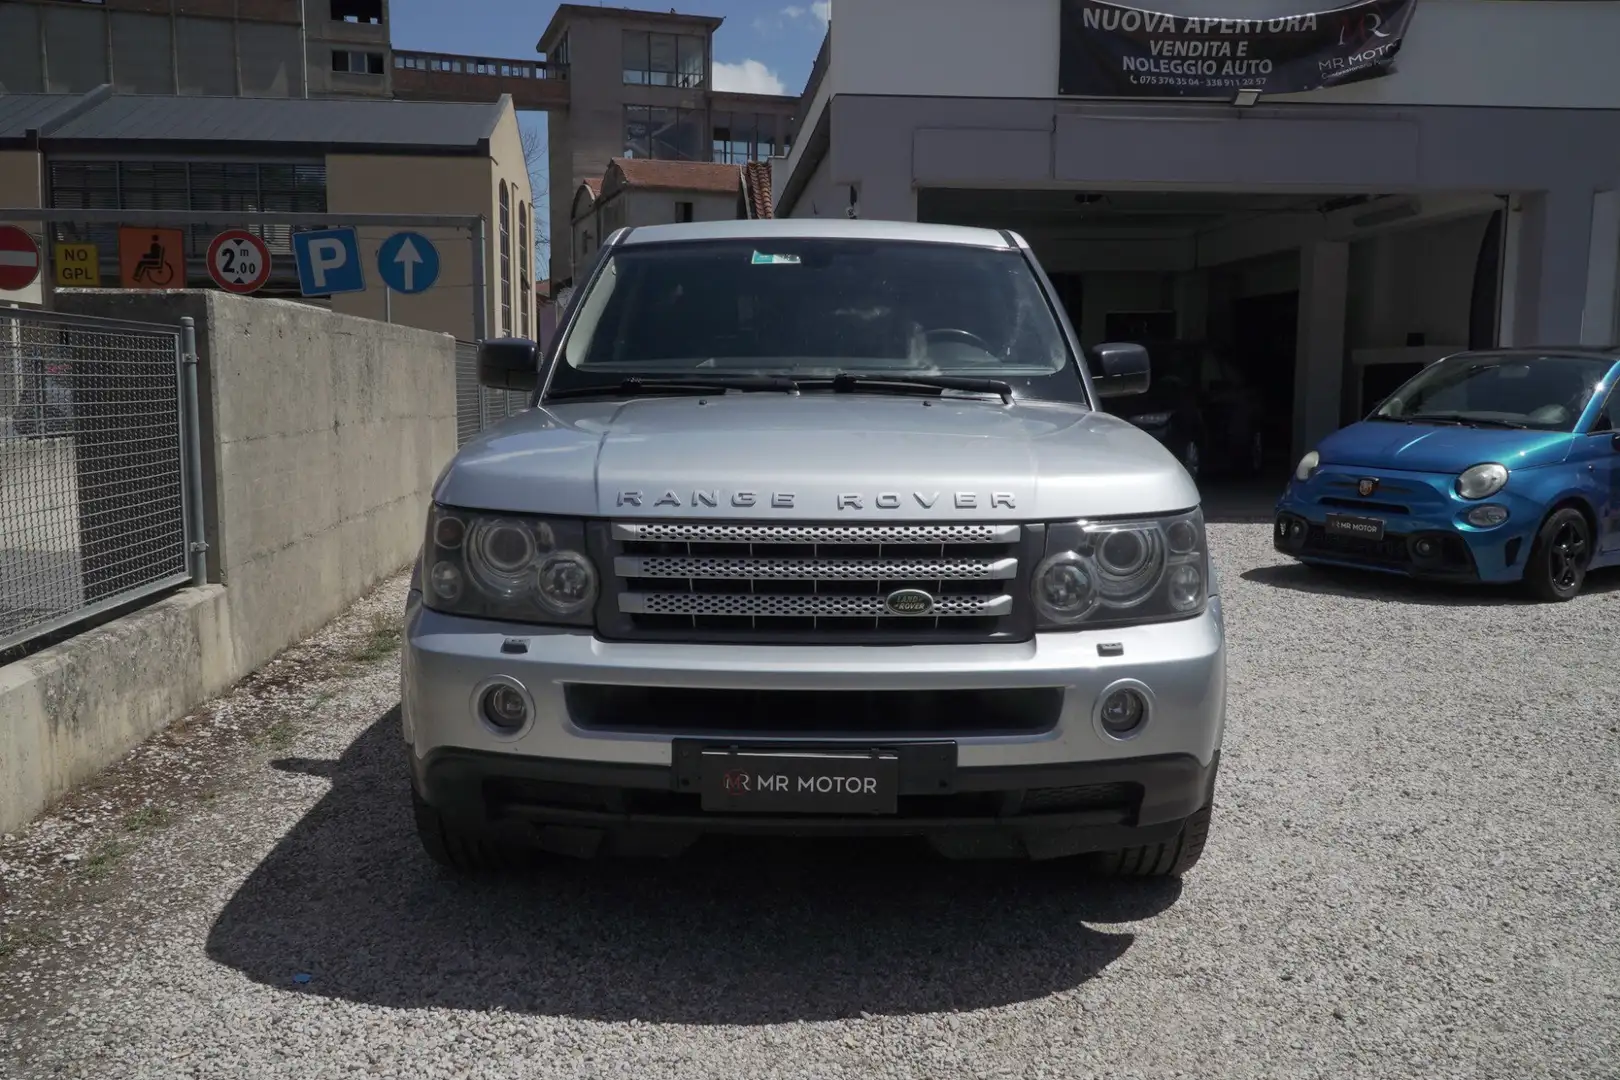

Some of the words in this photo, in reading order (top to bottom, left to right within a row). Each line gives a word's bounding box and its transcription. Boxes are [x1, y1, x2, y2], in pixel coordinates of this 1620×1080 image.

[1083, 7, 1175, 33] NUOVA
[1150, 39, 1231, 57] VENDITA
[1236, 41, 1248, 57] E
[1122, 55, 1217, 76] NOLEGGIO
[1221, 59, 1273, 76] AUTO
[1318, 57, 1345, 71] MR
[1140, 75, 1157, 84] 075
[1158, 76, 1174, 85] 376
[1175, 77, 1187, 86] 35
[1188, 78, 1199, 86] 04
[1205, 78, 1222, 87] 338
[1223, 78, 1240, 87] 911
[1242, 78, 1254, 86] 22
[64, 248, 88, 262] NO
[308, 237, 347, 288] P
[62, 267, 93, 280] GPL
[616, 489, 796, 508] RANGE
[837, 491, 1016, 510] ROVER
[1352, 524, 1377, 533] MOTOR
[898, 602, 926, 610] ROVER
[757, 775, 789, 792] MR
[798, 776, 877, 794] MOTOR
